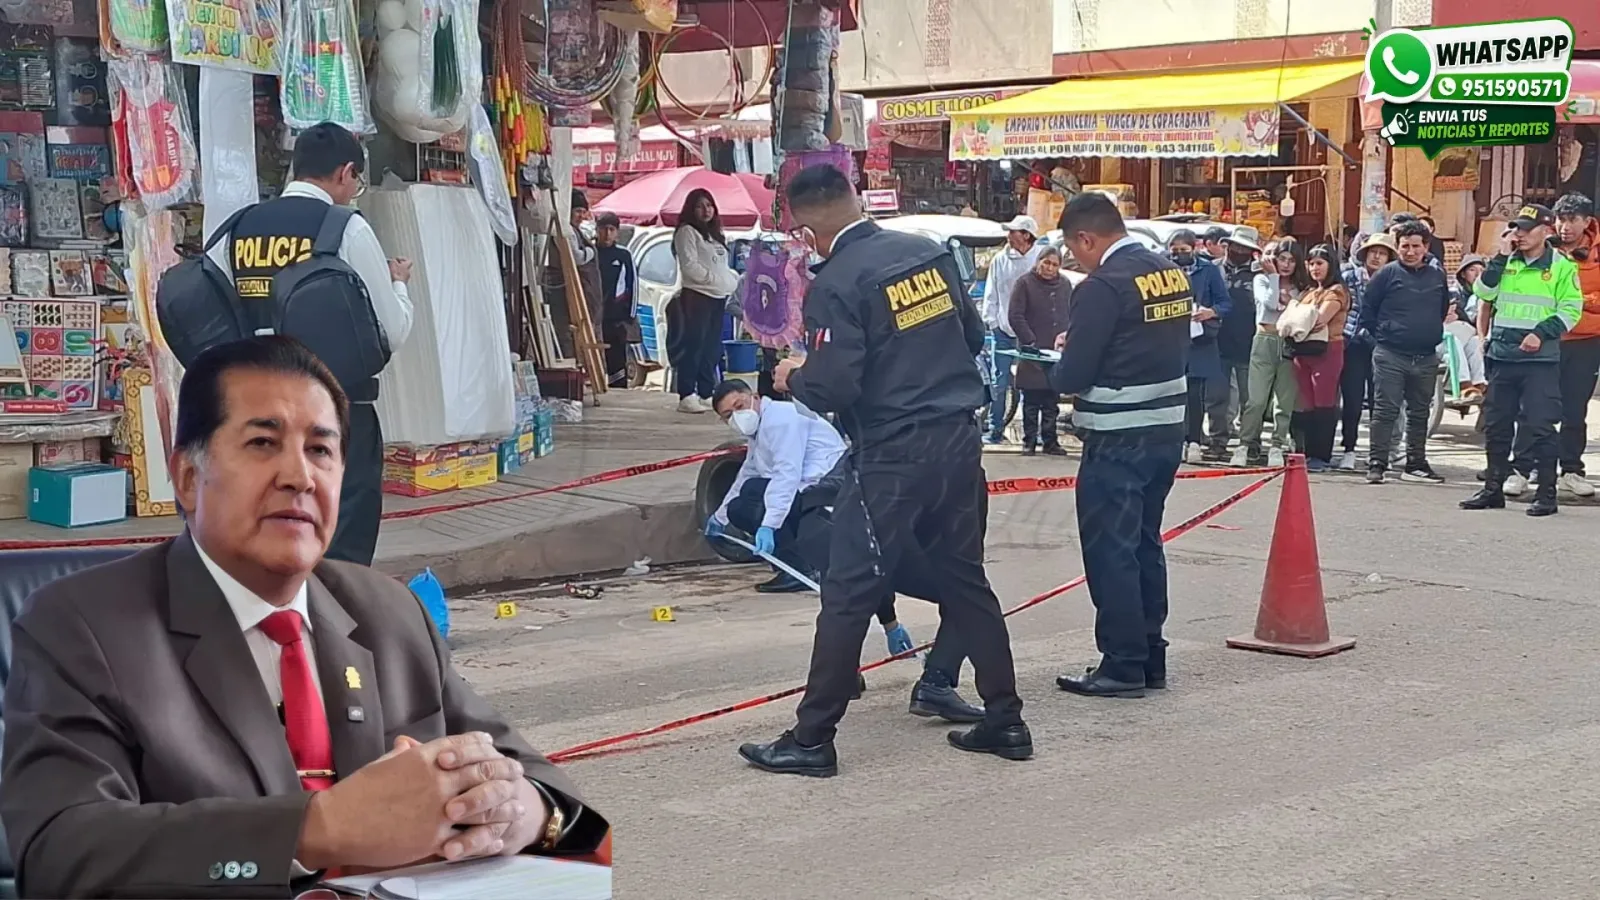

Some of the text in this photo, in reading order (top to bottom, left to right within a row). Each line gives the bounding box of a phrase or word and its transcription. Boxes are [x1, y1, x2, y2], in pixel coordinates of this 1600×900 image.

[1004, 116, 1040, 132] EMPORIO
[1042, 116, 1048, 130] Y
[1048, 113, 1098, 130] CARNICERIA
[1139, 113, 1150, 129] DE
[1003, 145, 1036, 155] VENTAS
[1049, 144, 1071, 153] POR
[1073, 143, 1102, 153] MAYOR
[1104, 143, 1111, 152] Y
[1113, 143, 1147, 153] MENOR
[1155, 143, 1175, 153] 943
[235, 235, 312, 270] POLICIA
[886, 267, 948, 311] POLICIA
[1134, 268, 1190, 300] POLICIA
[504, 604, 512, 616] 3
[659, 608, 667, 619] 2
